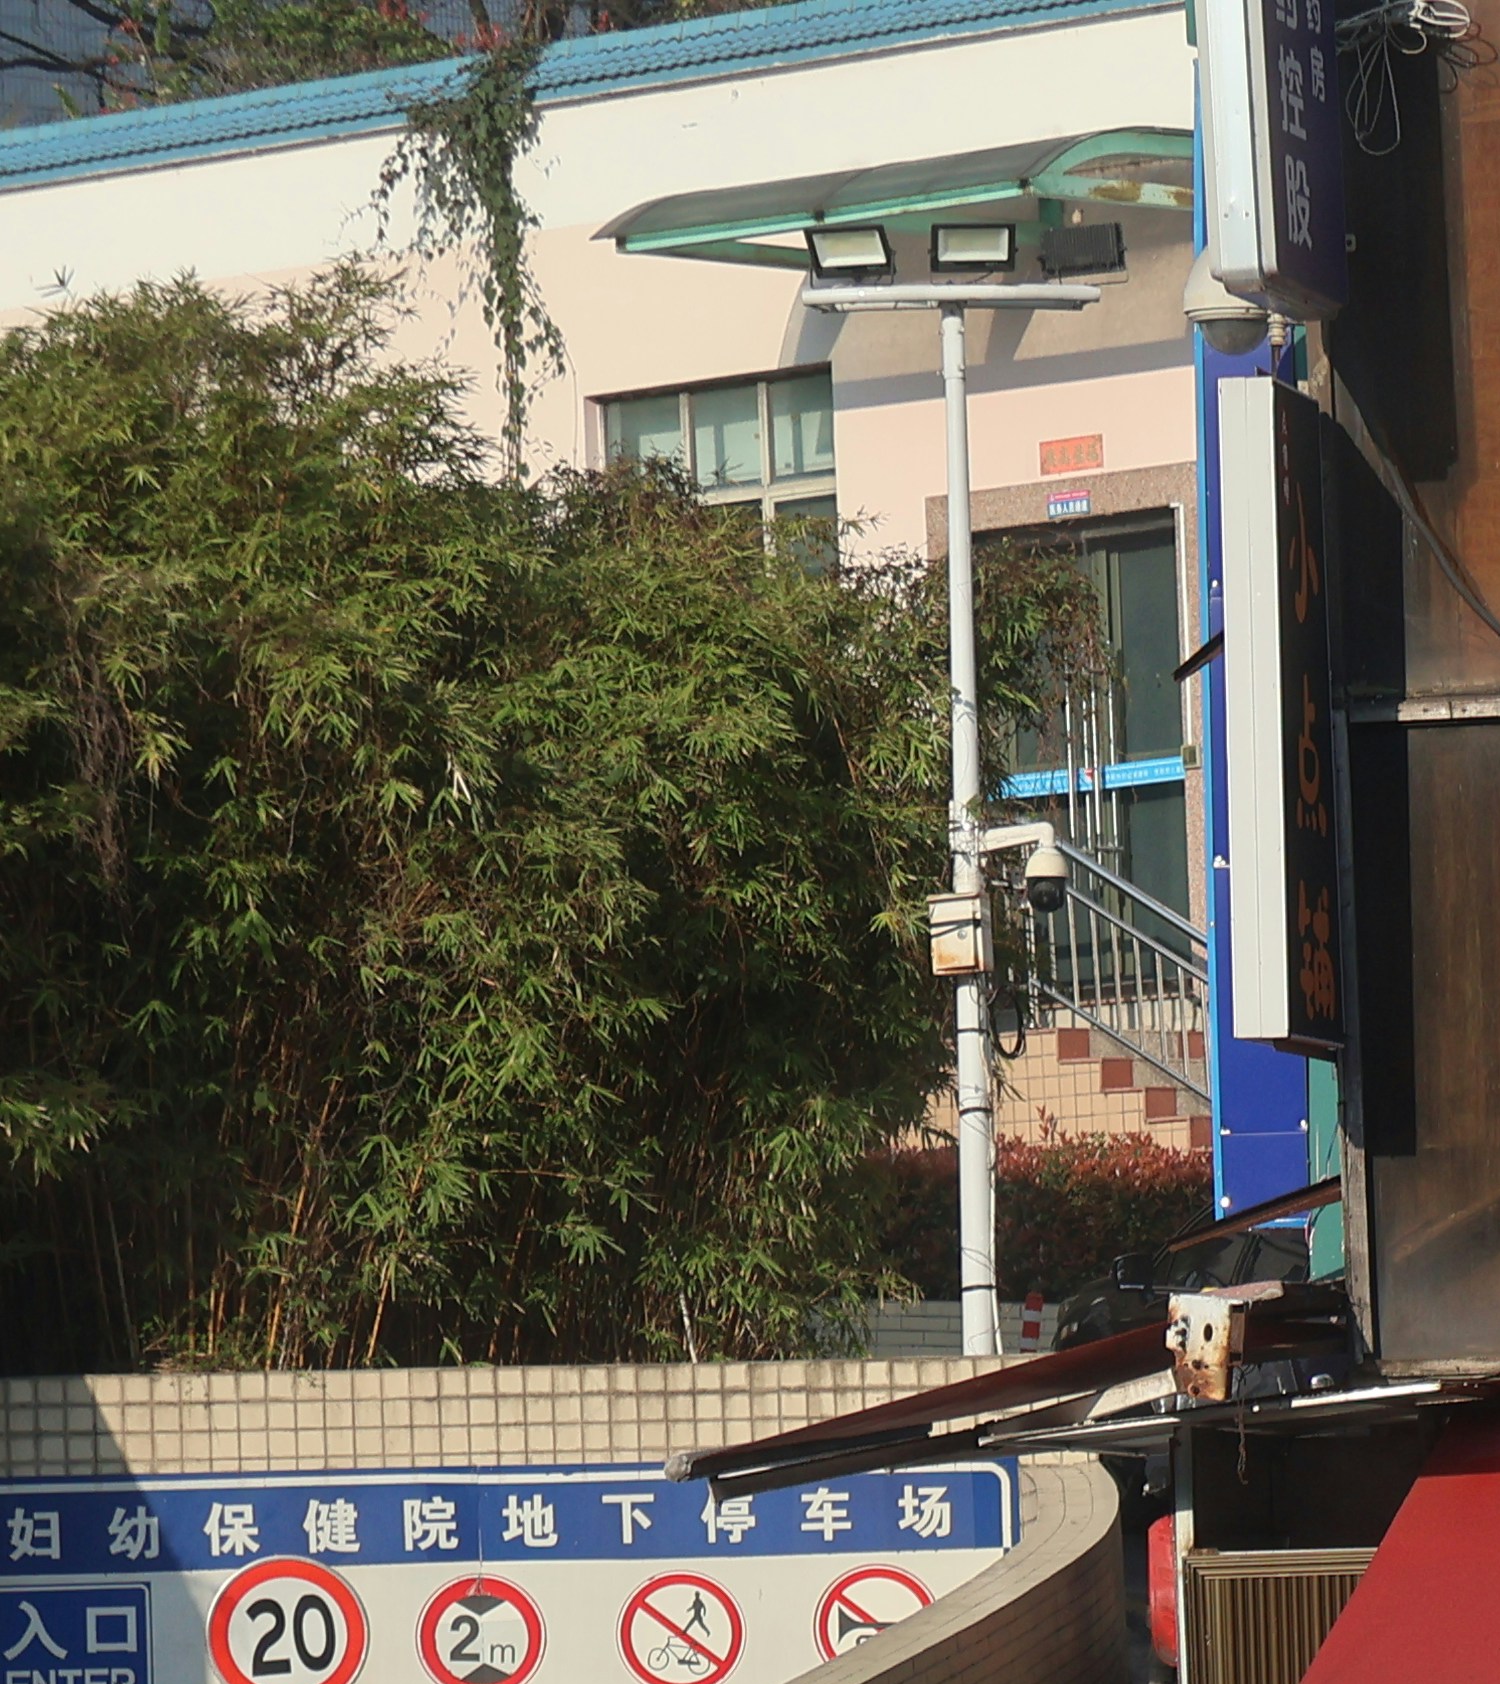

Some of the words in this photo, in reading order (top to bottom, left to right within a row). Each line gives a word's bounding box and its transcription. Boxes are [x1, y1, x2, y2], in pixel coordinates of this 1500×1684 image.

[6, 1484, 954, 1562] 妇幼保健院地下停车场
[4, 1602, 138, 1660] 入口
[246, 1593, 336, 1677] 20
